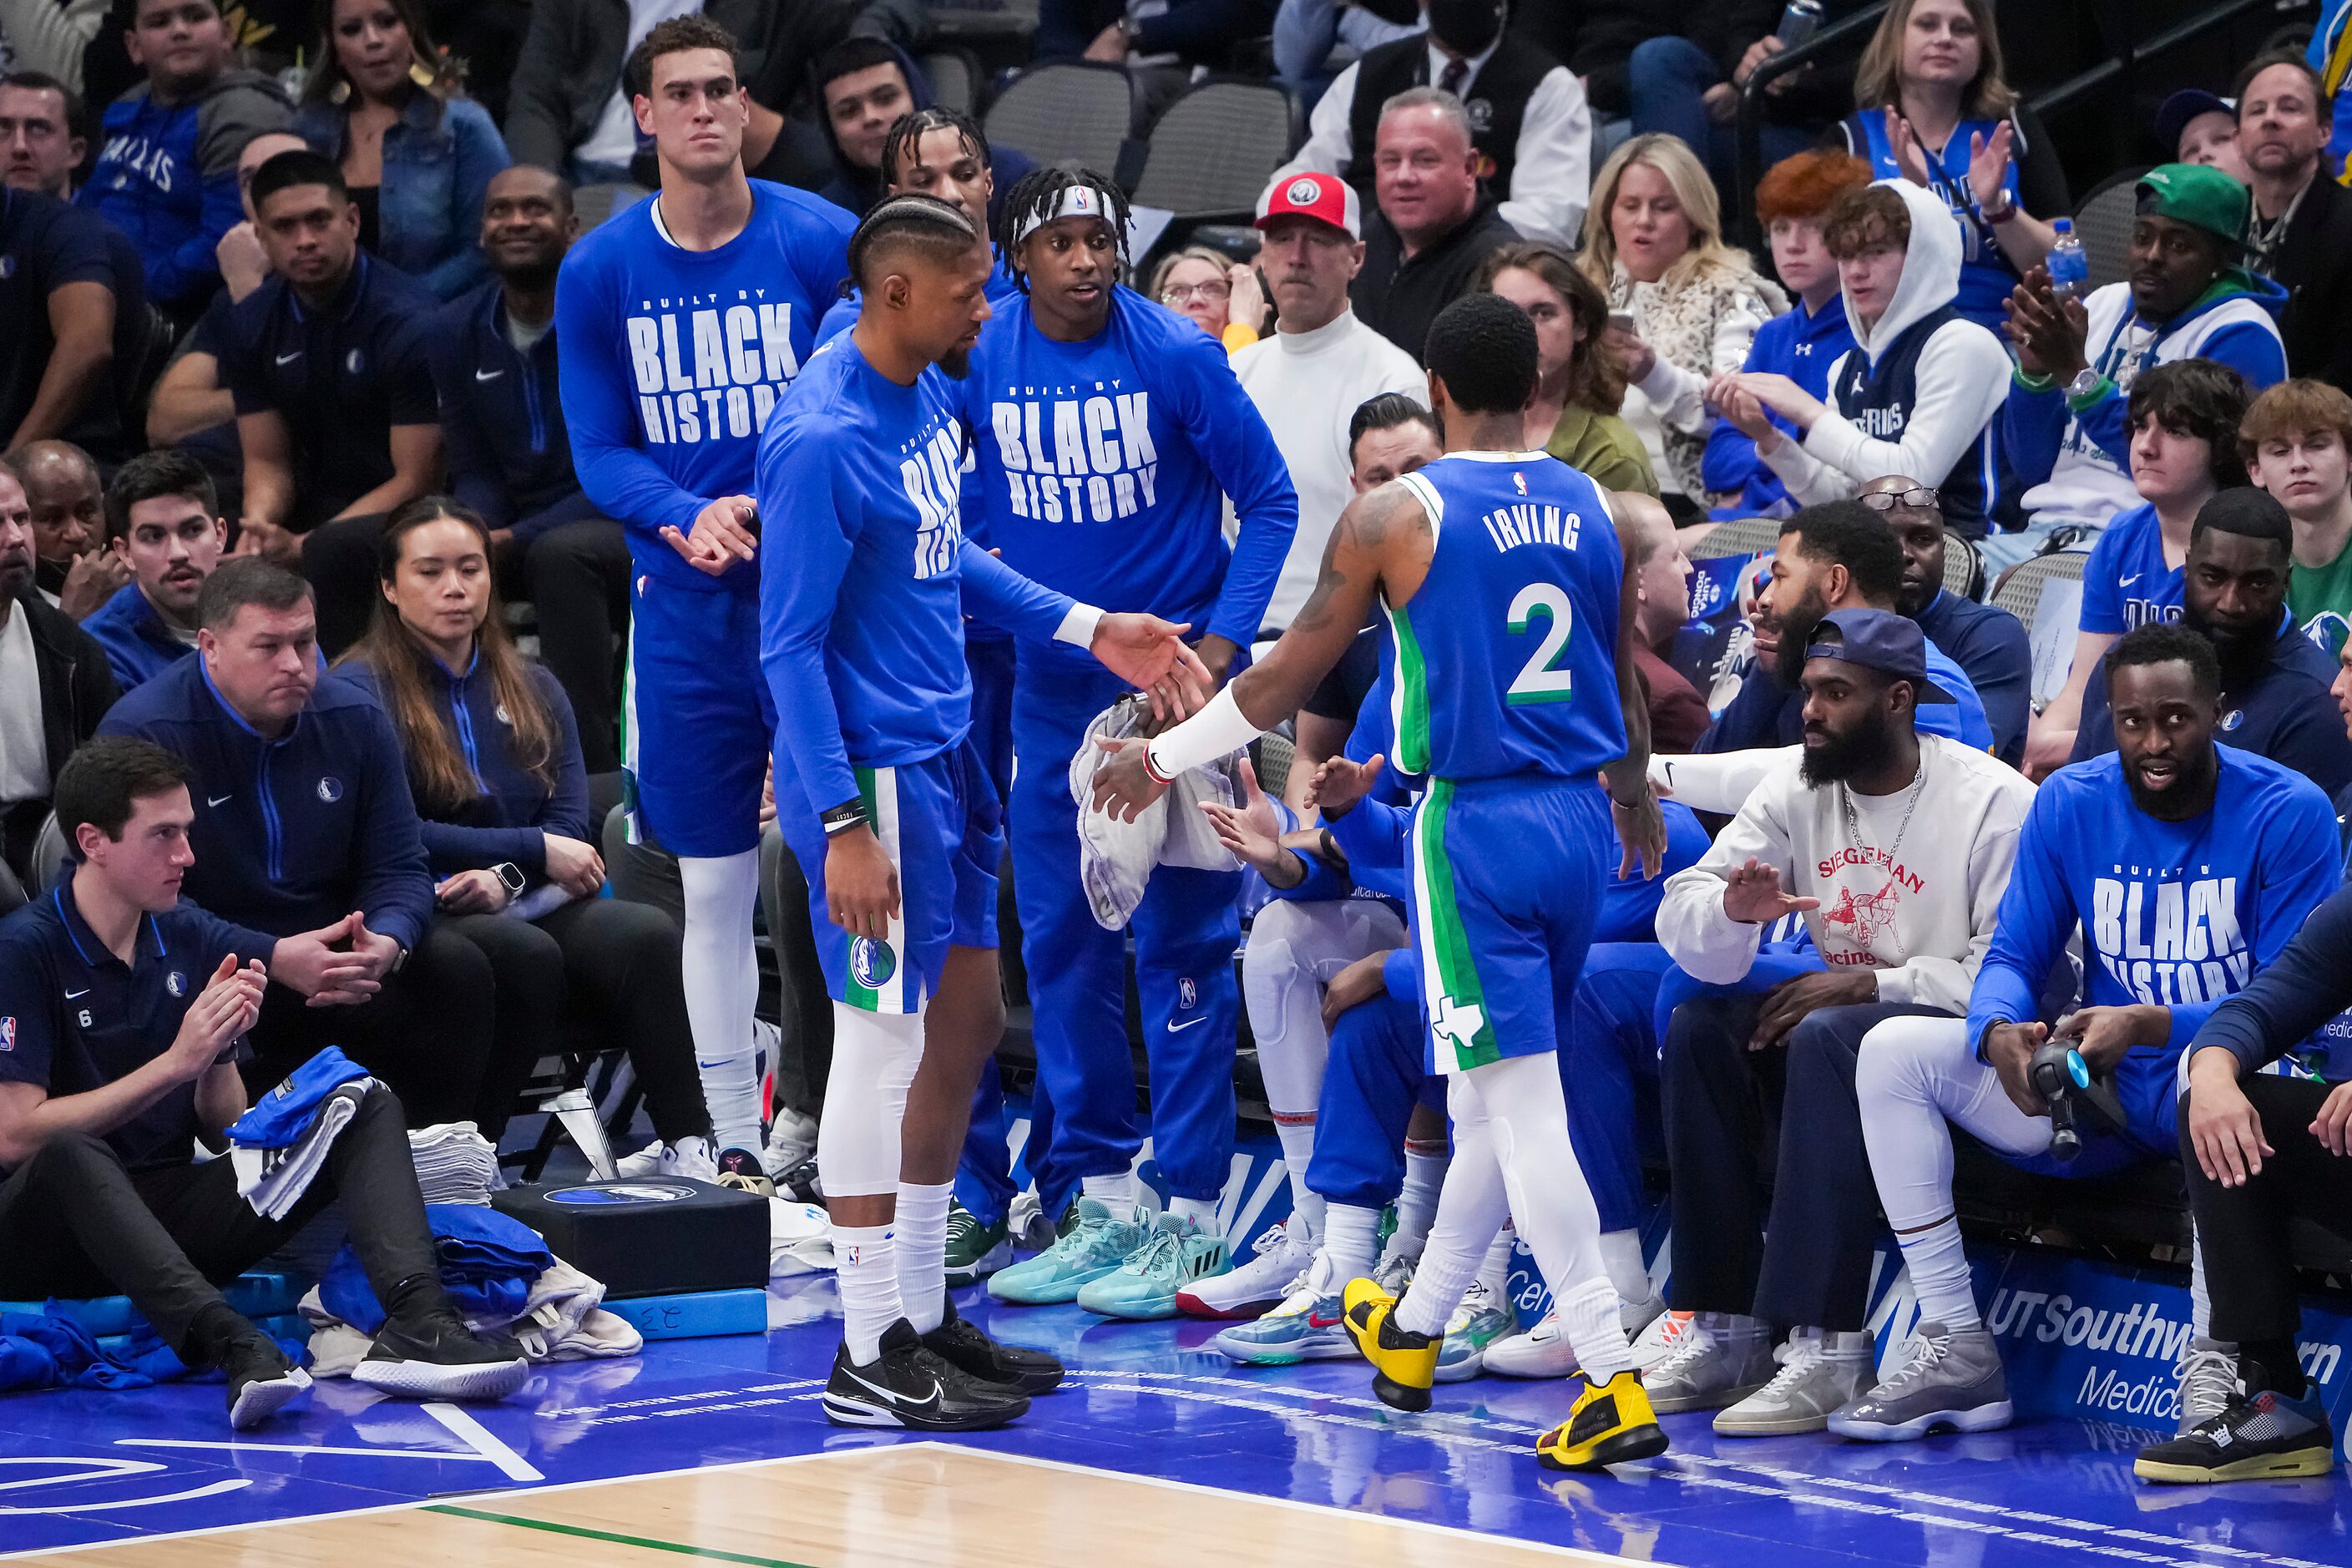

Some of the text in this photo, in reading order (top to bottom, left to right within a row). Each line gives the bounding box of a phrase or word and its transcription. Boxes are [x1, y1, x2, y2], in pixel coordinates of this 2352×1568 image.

[643, 289, 765, 311] BUILT BY
[627, 302, 799, 394] BLACK
[1009, 379, 1120, 397] BUILT BY
[901, 423, 933, 454] BUILT
[992, 391, 1158, 475] BLACK
[1005, 463, 1157, 523] HISTORY
[1482, 503, 1581, 554] IRVING
[1699, 576, 1712, 611] LUKA
[1507, 582, 1572, 706] 2
[836, 812, 853, 821] FOCUS
[2113, 863, 2211, 878] BUILT B
[2093, 877, 2246, 962] BLACK
[1825, 949, 1877, 966] acing
[78, 1009, 93, 1028] 6
[1506, 1270, 1554, 1313] Cen
[2076, 1366, 2182, 1419] Medic
